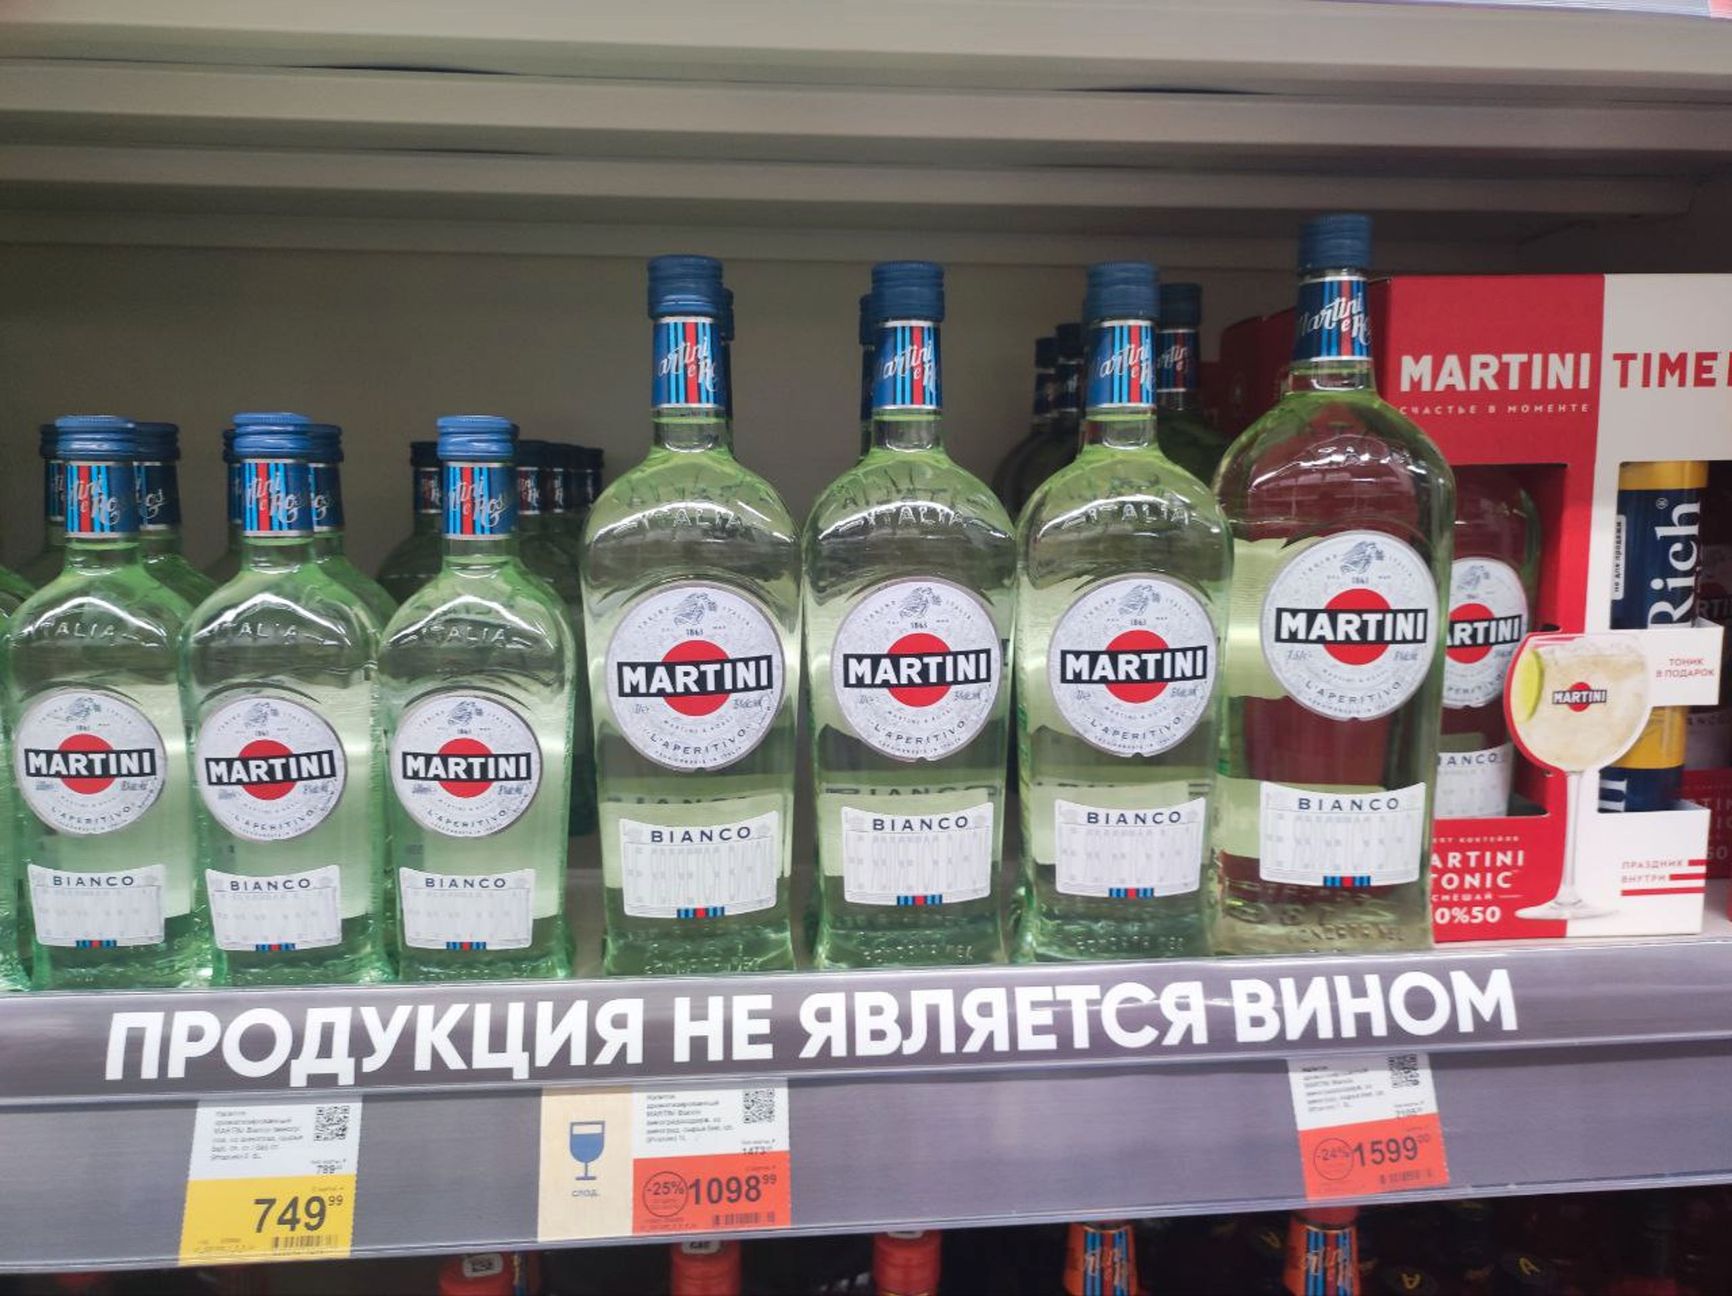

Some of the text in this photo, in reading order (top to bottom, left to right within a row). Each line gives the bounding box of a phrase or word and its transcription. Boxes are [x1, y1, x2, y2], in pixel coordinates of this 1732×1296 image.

[659, 336, 708, 377] artini
[883, 340, 932, 379] artini
[1100, 339, 1149, 377] artini
[1400, 352, 1591, 392] MARTINI
[1400, 403, 1588, 415] СЧАСТЬЕ В МОМЕНТЕ
[1647, 501, 1701, 630] Rich
[1280, 611, 1425, 641] MARTINI
[1446, 618, 1519, 645] RTINI
[848, 653, 988, 684] MARTINI
[1065, 650, 1204, 681] MARTINI
[1664, 668, 1715, 678] ПОДАРОК
[1669, 657, 1704, 666] ТОНИК
[622, 659, 768, 694] MARTINI
[1553, 690, 1606, 703] MARTINI
[874, 720, 966, 744] L'APERITIVO
[1090, 716, 1182, 740] L'APERITIVO
[650, 728, 746, 754] L'APERITIVO
[28, 752, 151, 775] MARTINI
[208, 753, 331, 783] MARTINI
[405, 755, 527, 779] MARTINI
[1437, 753, 1499, 766] IANCO
[1298, 798, 1399, 811] BIANCO
[873, 816, 968, 831] BIANCO
[1087, 811, 1181, 825] BIANCO
[651, 826, 751, 843] BIANCO
[1431, 850, 1525, 868] ARTINI
[1622, 859, 1683, 869] ПРАЗДНИК
[53, 875, 134, 887] BIANCO
[230, 878, 310, 891] BIANCO
[425, 877, 507, 889] BIANCO
[1622, 874, 1666, 883] ВНУТРИ
[1434, 905, 1502, 925] 0%50
[105, 969, 1518, 1087] ПРОДУКЦИЯ НЕ ЯВЛЯЕТСЯ ВИНОМ
[1353, 1136, 1418, 1167] 1599
[647, 1180, 685, 1195] -25%
[689, 1174, 777, 1205] 1098 99
[254, 1195, 344, 1234] 749 99
